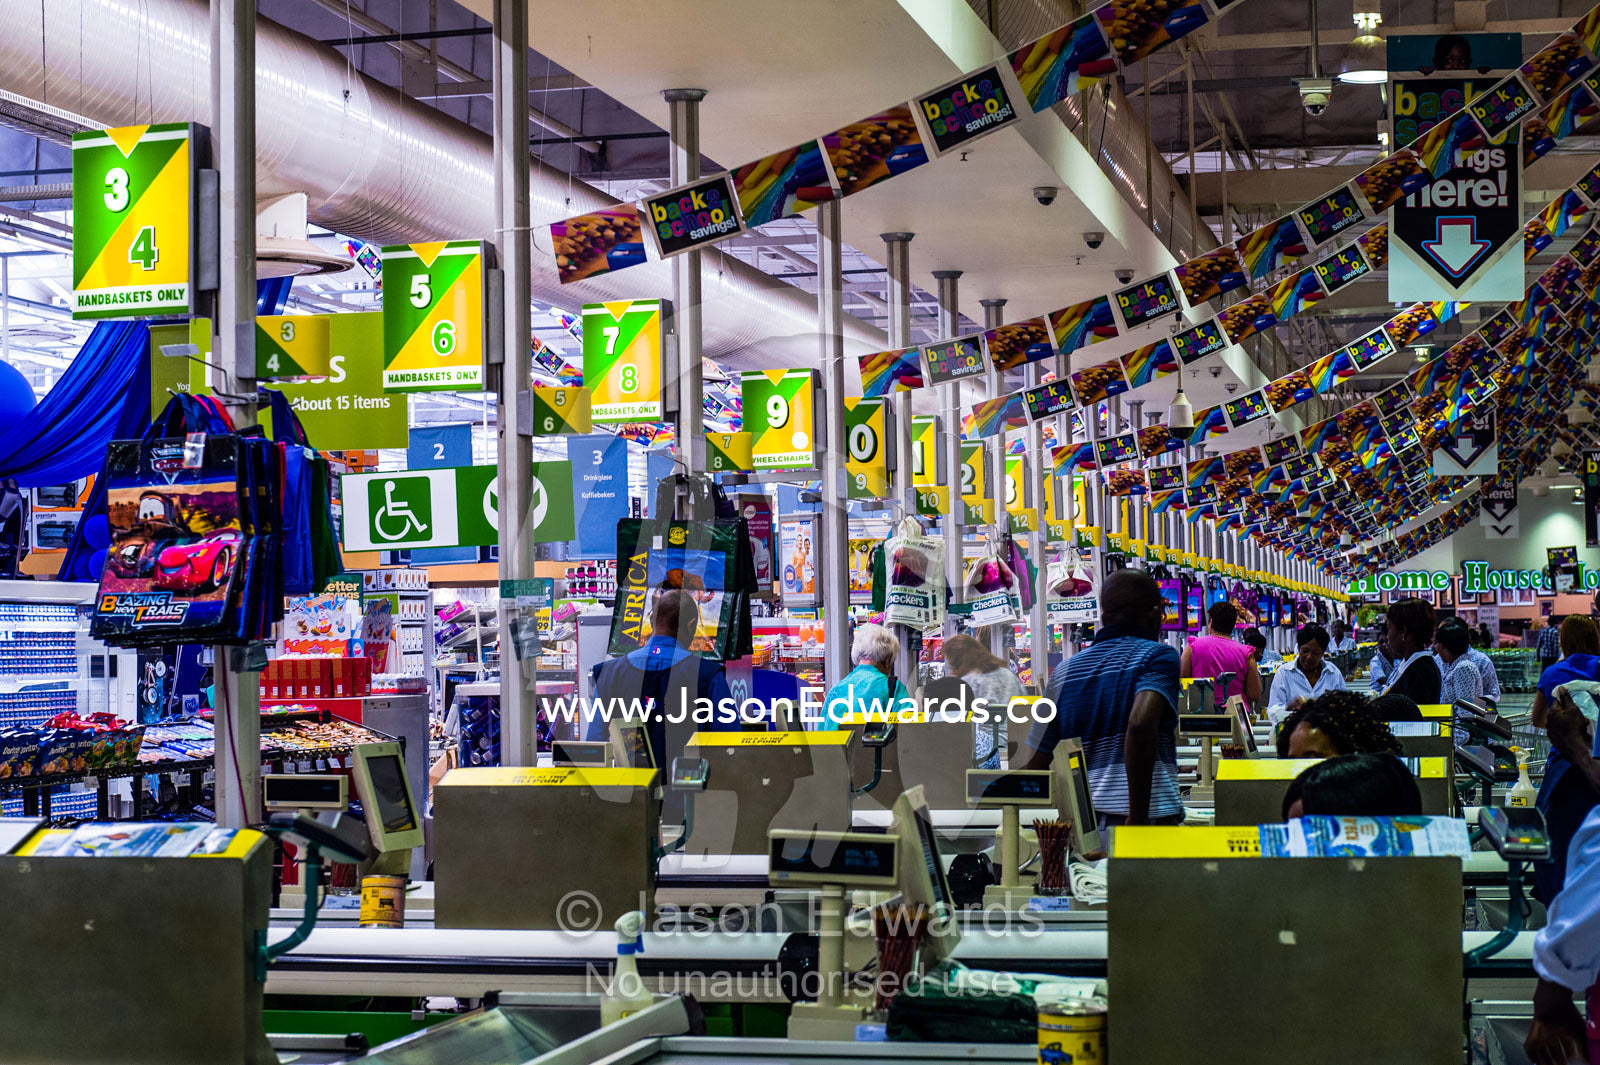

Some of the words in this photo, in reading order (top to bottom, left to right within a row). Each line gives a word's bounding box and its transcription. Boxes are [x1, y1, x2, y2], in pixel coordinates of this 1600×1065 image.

[965, 103, 1012, 133] savings!
[104, 167, 130, 213] 3
[690, 216, 737, 241] savings!
[128, 226, 158, 270] 4
[77, 292, 153, 307] HANDBASKETS
[158, 288, 185, 301] ONLY
[409, 274, 432, 308] 5
[280, 322, 295, 342] 3
[432, 319, 456, 356] 6
[603, 326, 620, 355] 7
[266, 354, 281, 372] 4
[388, 372, 452, 383] HANDBASKETS
[456, 370, 478, 380] ONLY
[619, 363, 638, 393] 8
[291, 395, 332, 411] About
[336, 396, 350, 410] 15
[354, 395, 391, 409] items
[555, 391, 566, 406] 5
[639, 405, 656, 415] ONLY
[766, 395, 789, 429] 9
[544, 416, 554, 431] 6
[723, 436, 731, 448] 7
[847, 424, 877, 463] 0
[433, 443, 445, 460] 2
[592, 450, 604, 465] 3
[714, 457, 722, 469] 8
[855, 473, 867, 490] 9
[920, 492, 939, 508] 10
[970, 505, 983, 518] 11
[1013, 515, 1029, 528] 12
[1049, 525, 1064, 536] 13
[1080, 532, 1093, 542] 14
[1109, 538, 1122, 548] 15
[1149, 549, 1160, 558] 17
[1463, 561, 1544, 593] House
[327, 581, 359, 592] etter
[100, 595, 168, 611] BLAZING
[622, 551, 648, 642] AFRICA
[973, 596, 1007, 610] Checkers
[135, 605, 184, 621] TRAILS
[1051, 601, 1092, 610] Checkers
